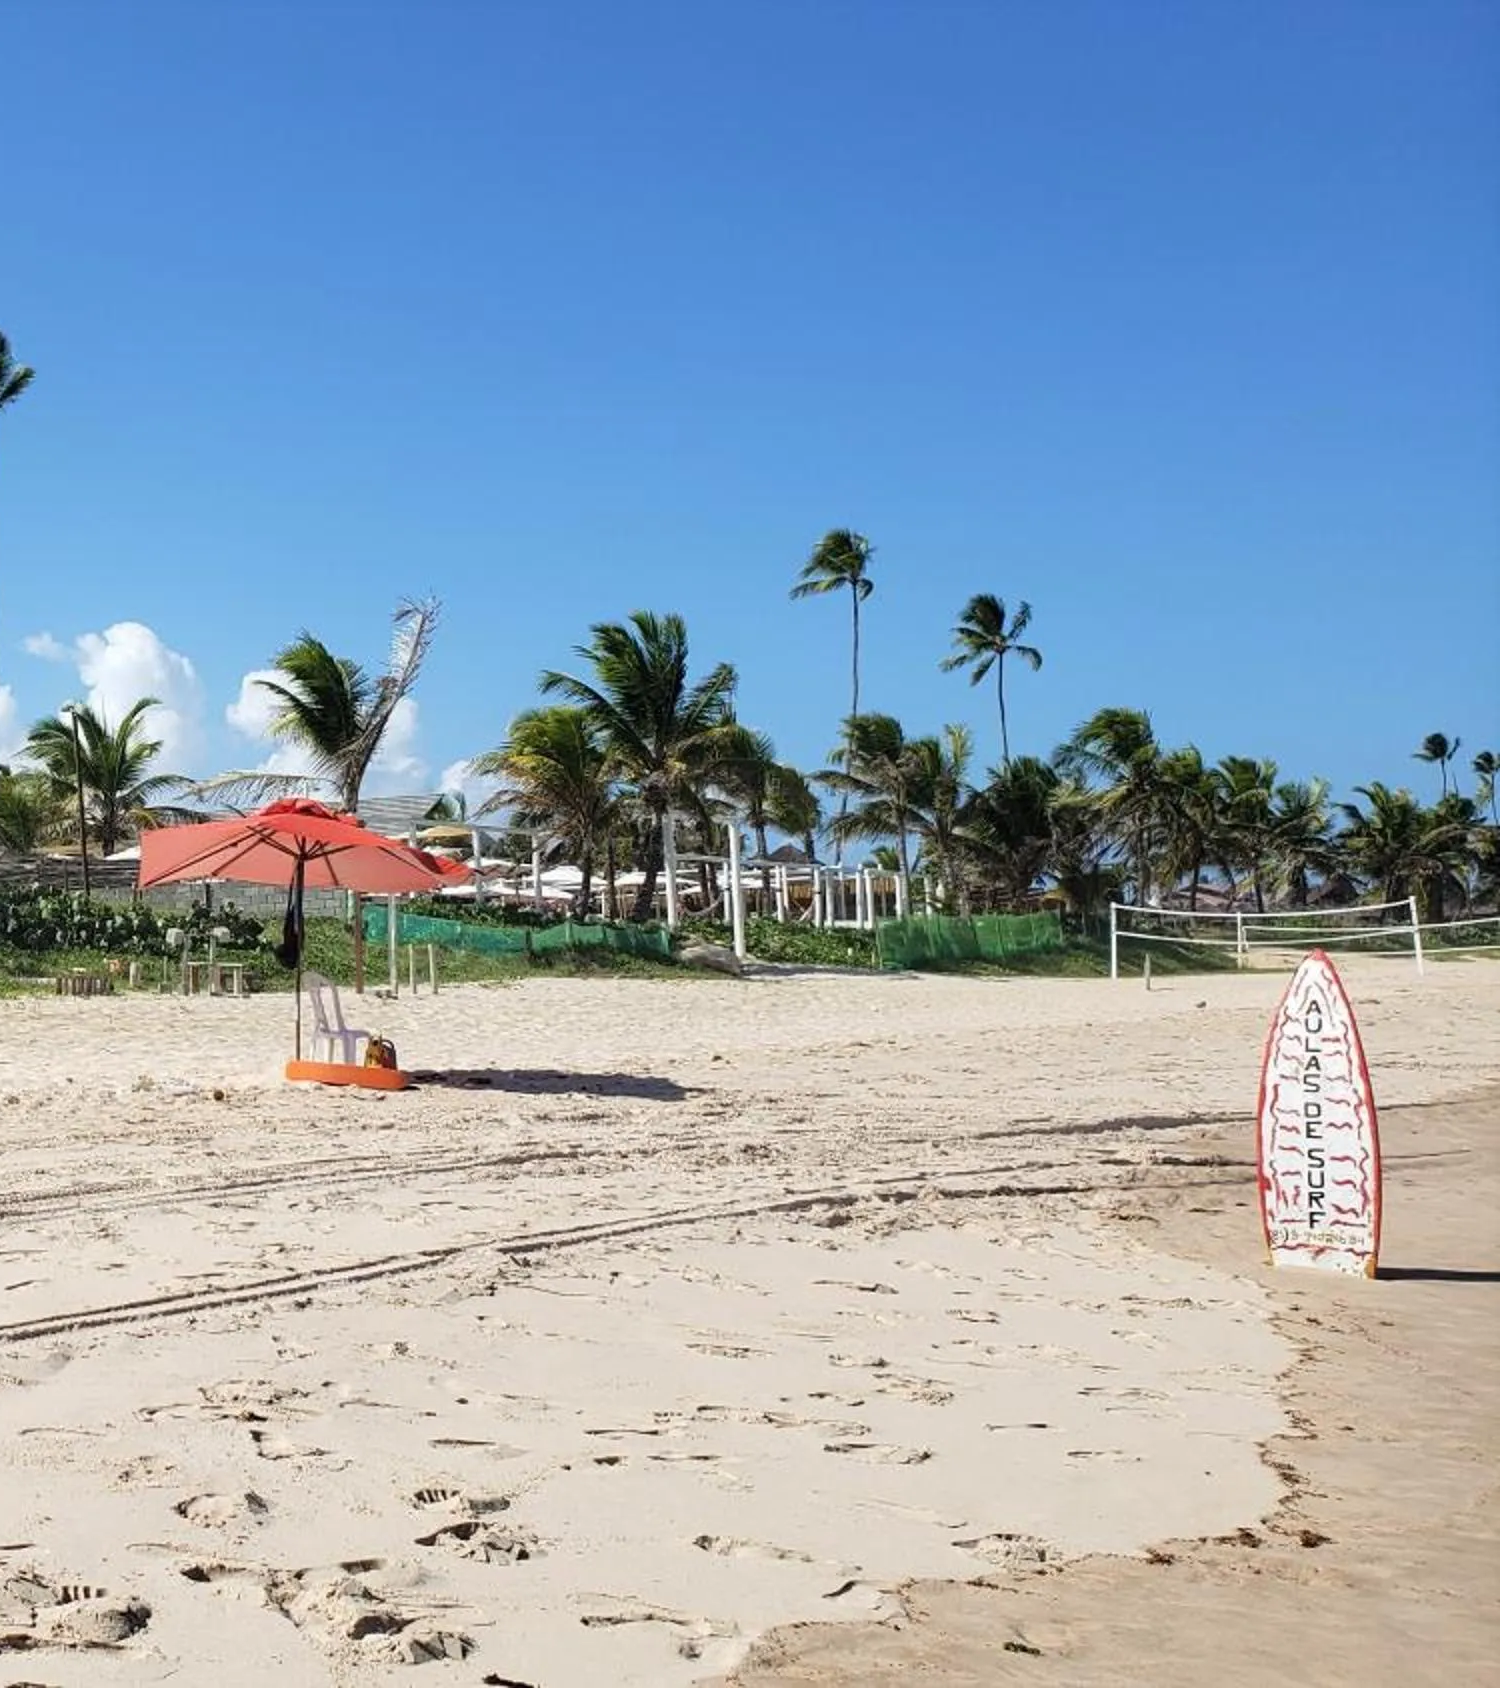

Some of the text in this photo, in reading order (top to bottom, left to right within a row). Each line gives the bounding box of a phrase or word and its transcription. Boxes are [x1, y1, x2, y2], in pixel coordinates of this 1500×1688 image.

[1303, 999, 1326, 1229] AULAS DE SURF
